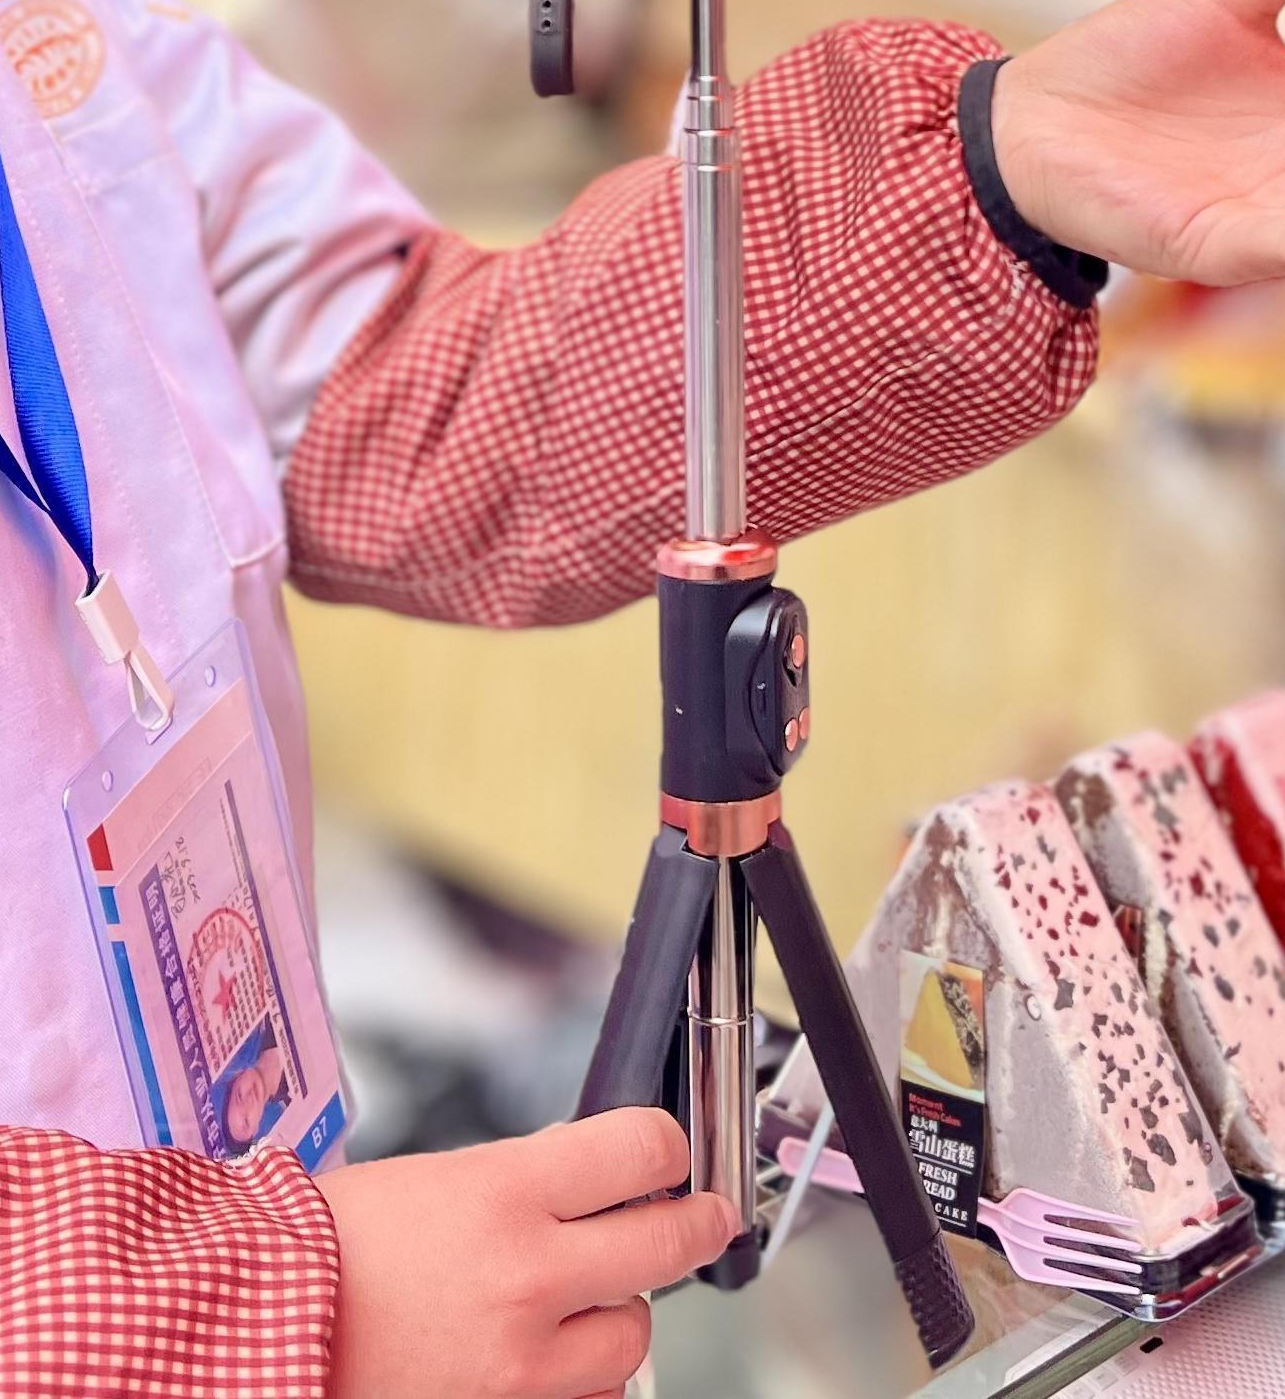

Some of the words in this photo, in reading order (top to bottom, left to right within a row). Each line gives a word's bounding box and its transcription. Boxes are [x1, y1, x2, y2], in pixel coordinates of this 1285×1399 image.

[311, 1116, 327, 1149] B7
[909, 1129, 976, 1168] 雪山蛋糕
[918, 1161, 958, 1186] FRESH
[923, 1179, 956, 1201] READ
[934, 1202, 968, 1222] CAKE
